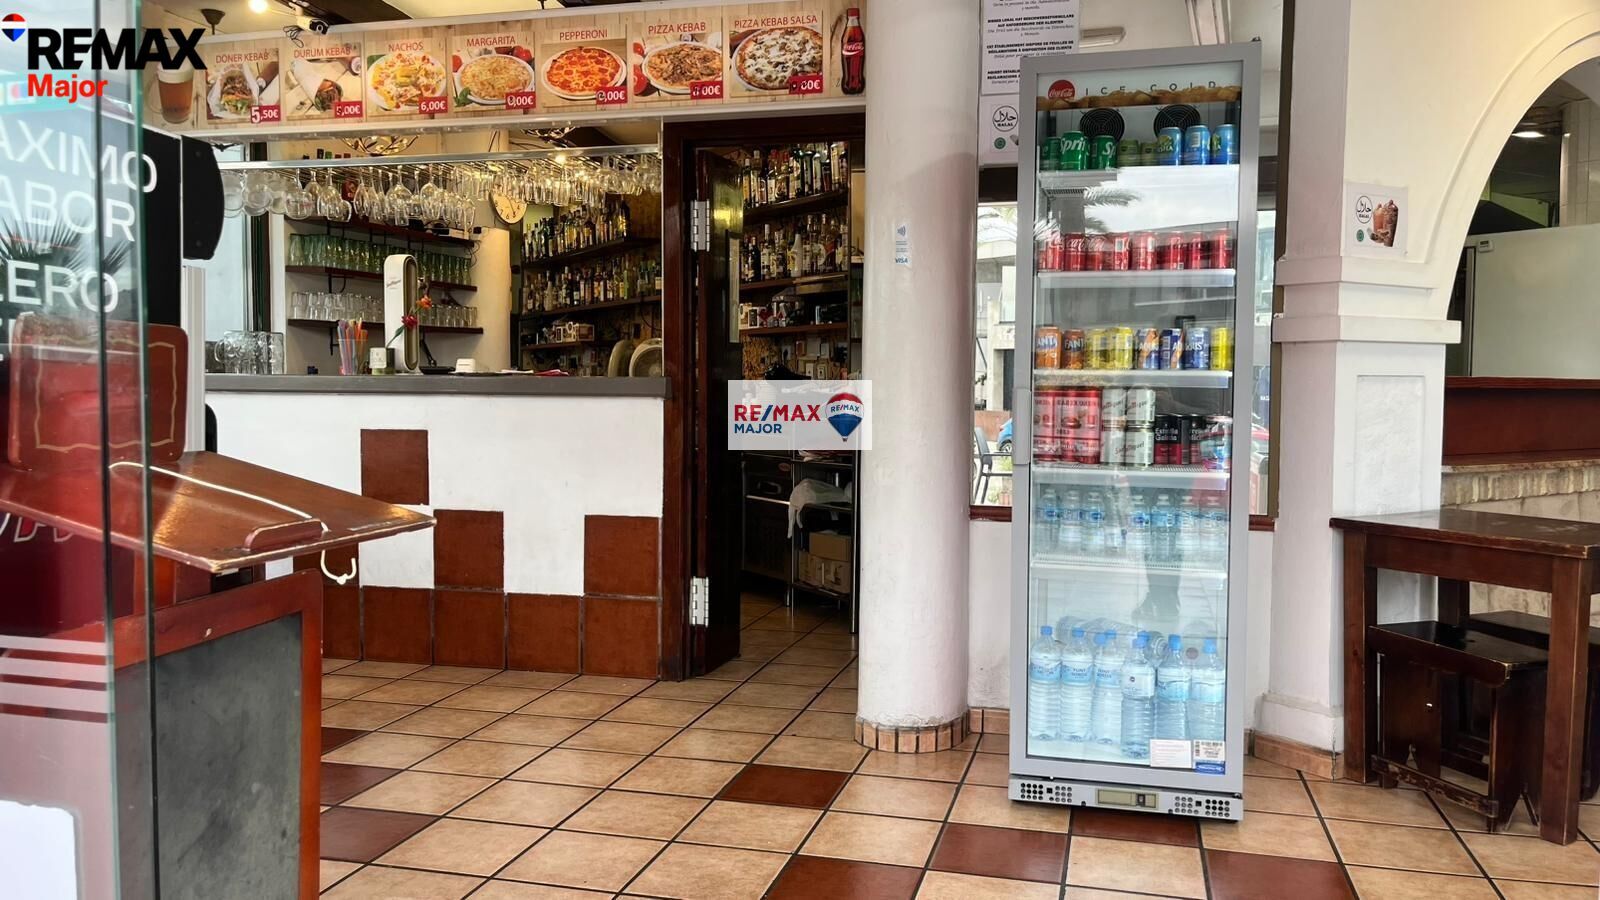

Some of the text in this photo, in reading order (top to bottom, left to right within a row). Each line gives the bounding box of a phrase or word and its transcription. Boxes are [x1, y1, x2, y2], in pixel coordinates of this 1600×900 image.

[734, 15, 817, 28] PIZZA KEBAB SALSA
[649, 22, 706, 34] PIZZA KEBAB
[560, 29, 608, 40] PEPPERONI
[389, 42, 423, 51] NACHOS
[467, 36, 515, 47] MARGARITA
[216, 52, 268, 63] DONER KEBAB
[294, 47, 350, 59] DURUM KEBAB
[421, 100, 446, 111] 6,00€
[251, 106, 278, 123] 5,50€
[0, 259, 119, 313] ERO
